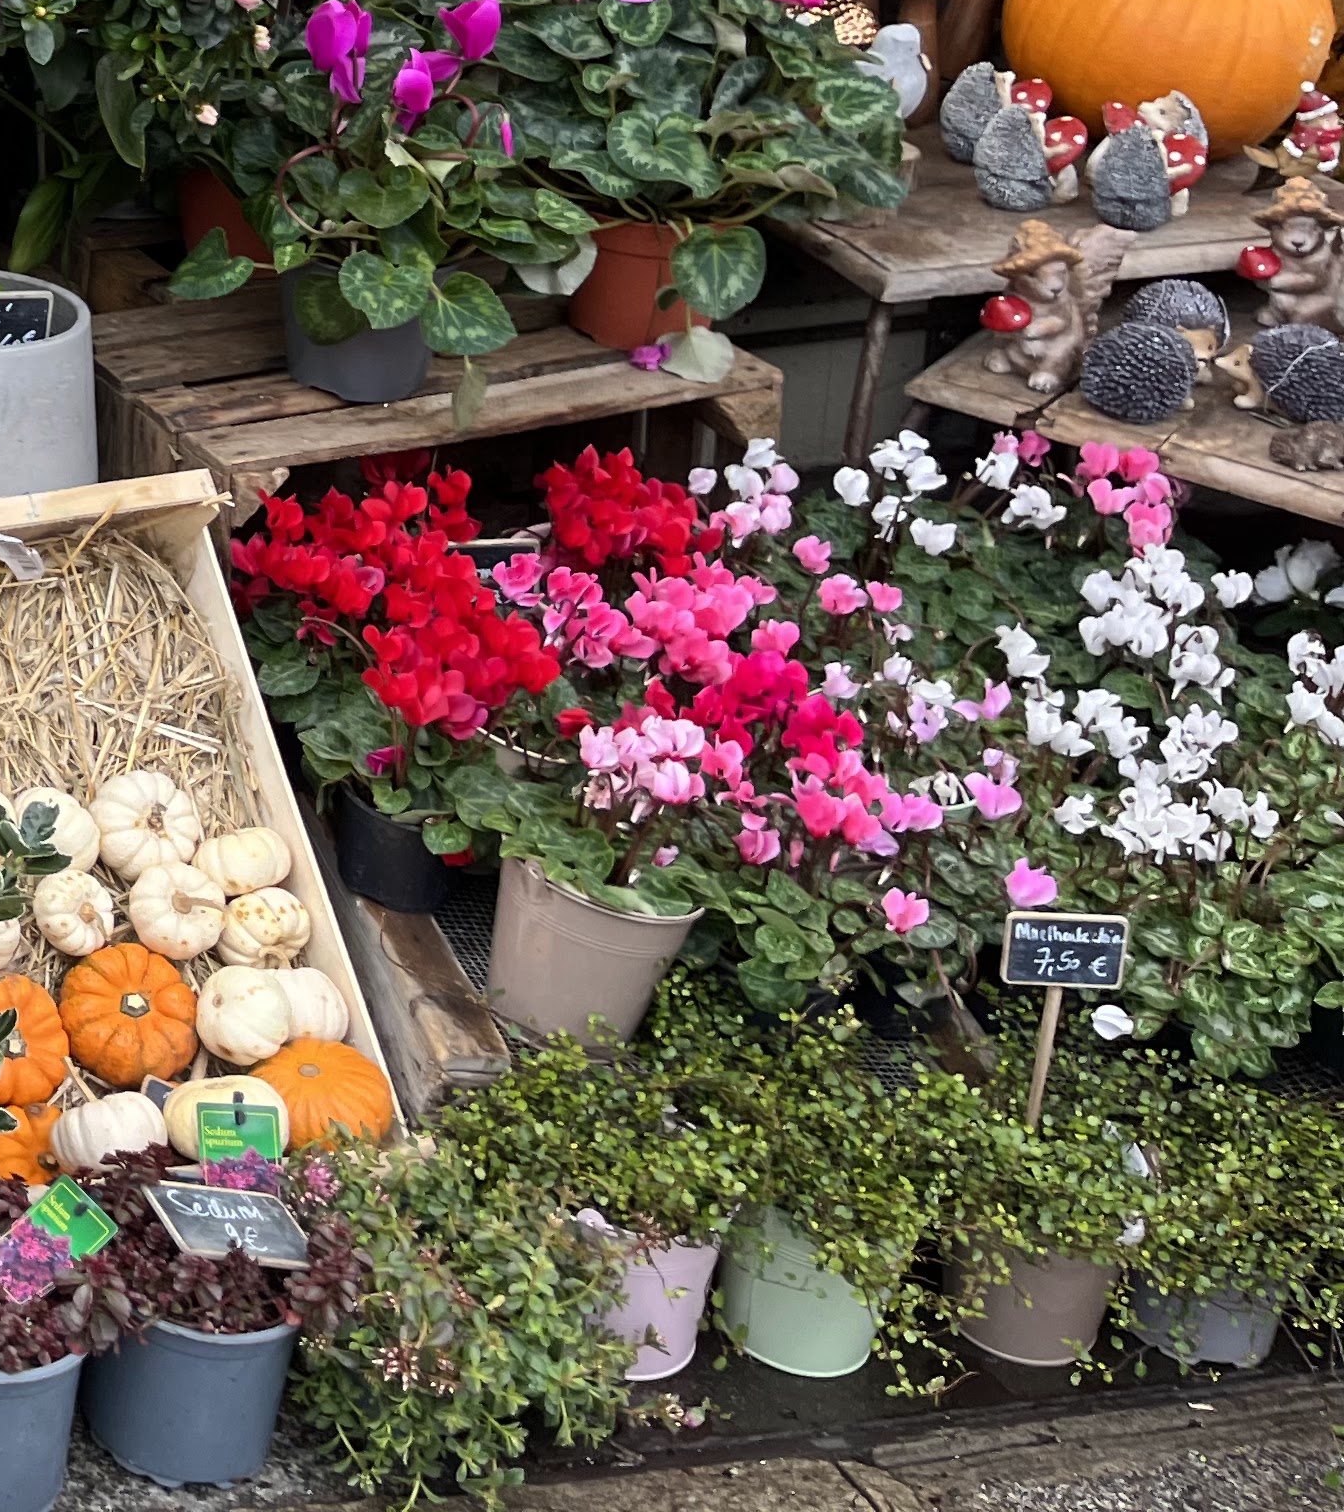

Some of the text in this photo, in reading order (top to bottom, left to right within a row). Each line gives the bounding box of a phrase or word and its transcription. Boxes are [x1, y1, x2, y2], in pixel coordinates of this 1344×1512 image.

[203, 1125, 237, 1137] Sedum
[203, 1137, 244, 1148] spurium
[49, 1193, 71, 1221] Sedum
